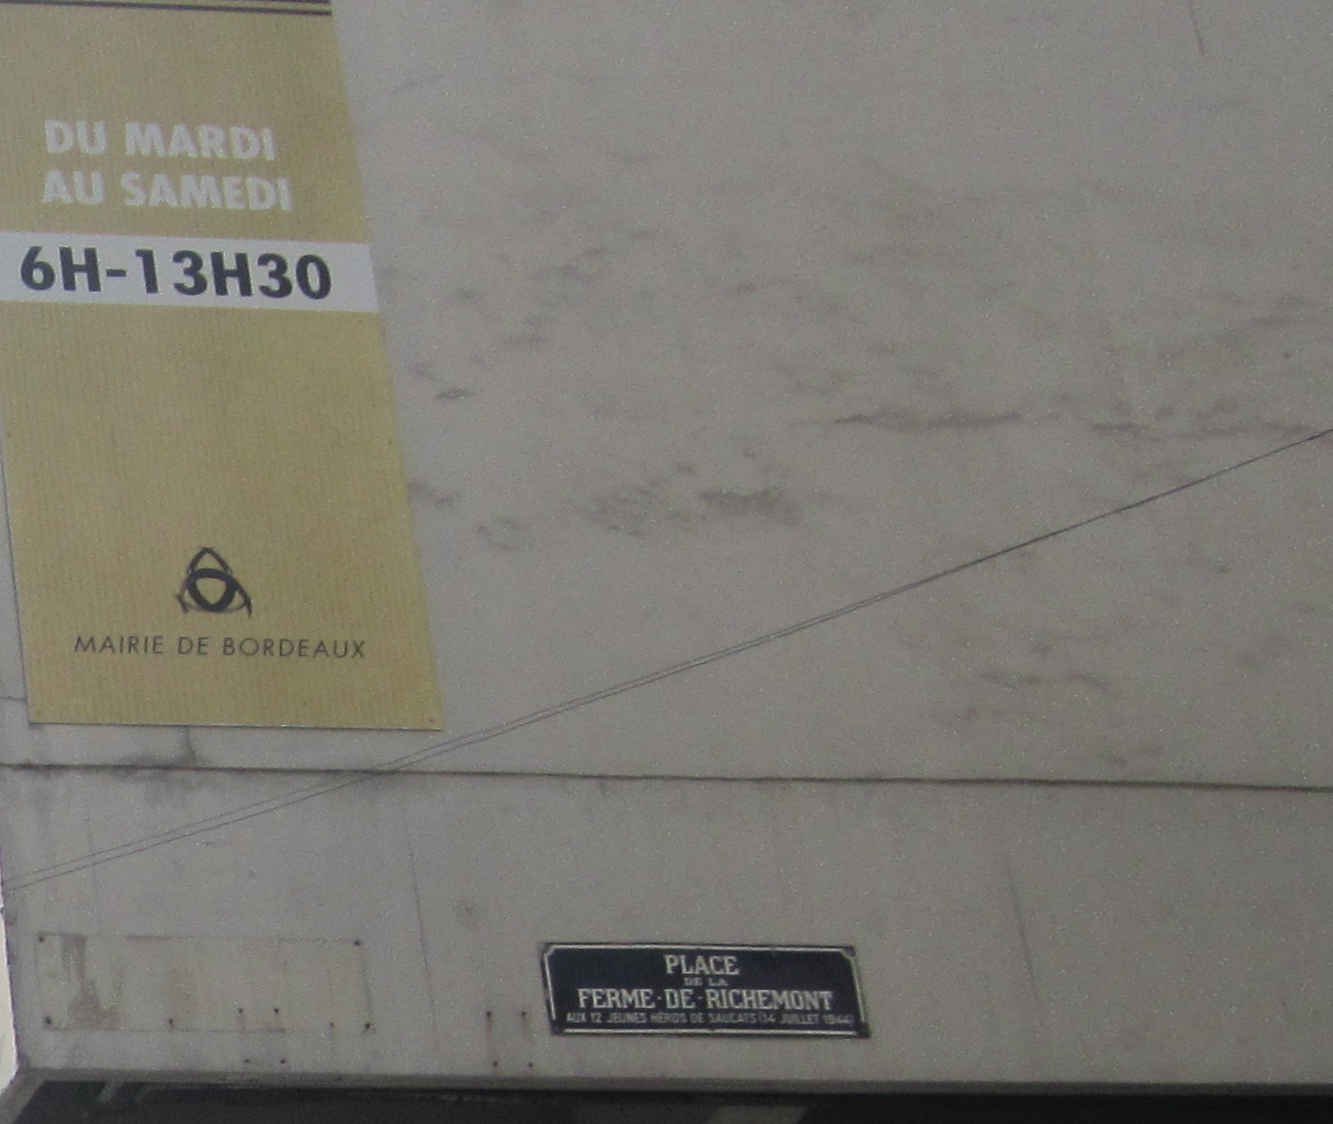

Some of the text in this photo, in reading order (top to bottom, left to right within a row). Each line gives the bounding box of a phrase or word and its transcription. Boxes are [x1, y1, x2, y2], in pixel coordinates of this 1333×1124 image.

[44, 119, 276, 161] DU MARDI
[42, 169, 293, 212] AU SAMEDI
[19, 243, 333, 300] 6H-13H30
[74, 634, 367, 660] MAIRIE DE BORDEAUX
[664, 954, 740, 975] PLACE
[683, 977, 728, 987] DE LA
[565, 1012, 587, 1023] AUX
[590, 1012, 602, 1023] 12
[606, 1012, 647, 1024] JEUNES
[689, 1012, 705, 1024] DE
[779, 1013, 820, 1025] JUILLET
